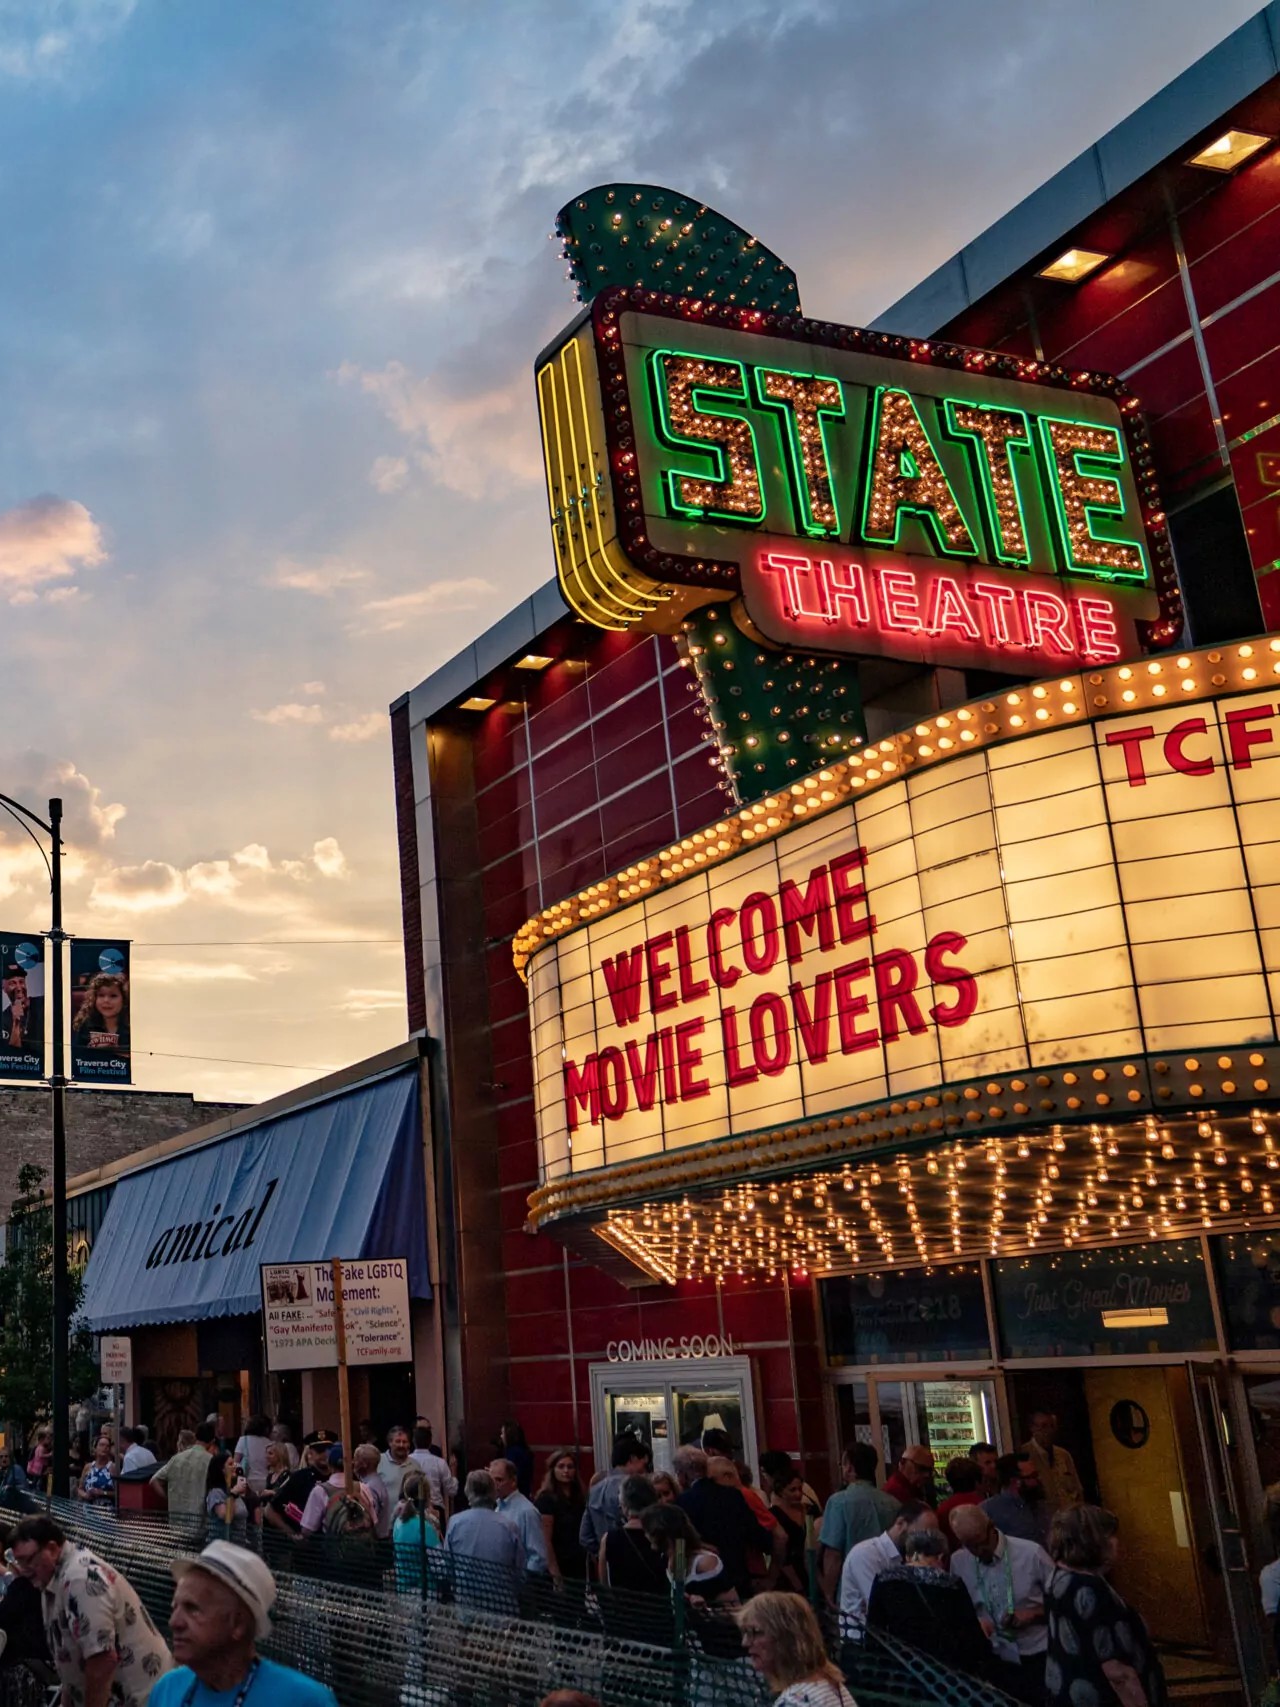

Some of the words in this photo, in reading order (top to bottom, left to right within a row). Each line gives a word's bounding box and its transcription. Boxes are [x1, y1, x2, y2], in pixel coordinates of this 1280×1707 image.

[651, 349, 1149, 580] STATE
[764, 553, 1121, 658] THEATRE
[1105, 703, 1280, 787] TCF
[600, 846, 877, 1027] WELCOME
[564, 1015, 711, 1132] MOVIE
[720, 931, 978, 1089] LOVERS
[10, 1062, 40, 1071] Festival
[23, 1055, 40, 1065] City
[76, 1058, 109, 1068] Traverse
[109, 1059, 126, 1069] City
[79, 1066, 96, 1074] Film
[97, 1067, 126, 1076] Festival
[145, 1177, 279, 1270] amical
[367, 1263, 404, 1280] LGBTQ
[316, 1284, 381, 1302] Moement:
[1017, 1282, 1058, 1320] Just
[1063, 1278, 1118, 1319] Great
[1116, 1273, 1191, 1306] Movies
[269, 1311, 279, 1320] All
[281, 1310, 305, 1321] FAKE:
[269, 1325, 290, 1336] "Gay
[291, 1323, 333, 1334] Manifesto
[296, 1337, 313, 1346] APA
[606, 1337, 676, 1362] COMING
[680, 1333, 734, 1359] SOON
[356, 1344, 402, 1357] TCFamily.org
